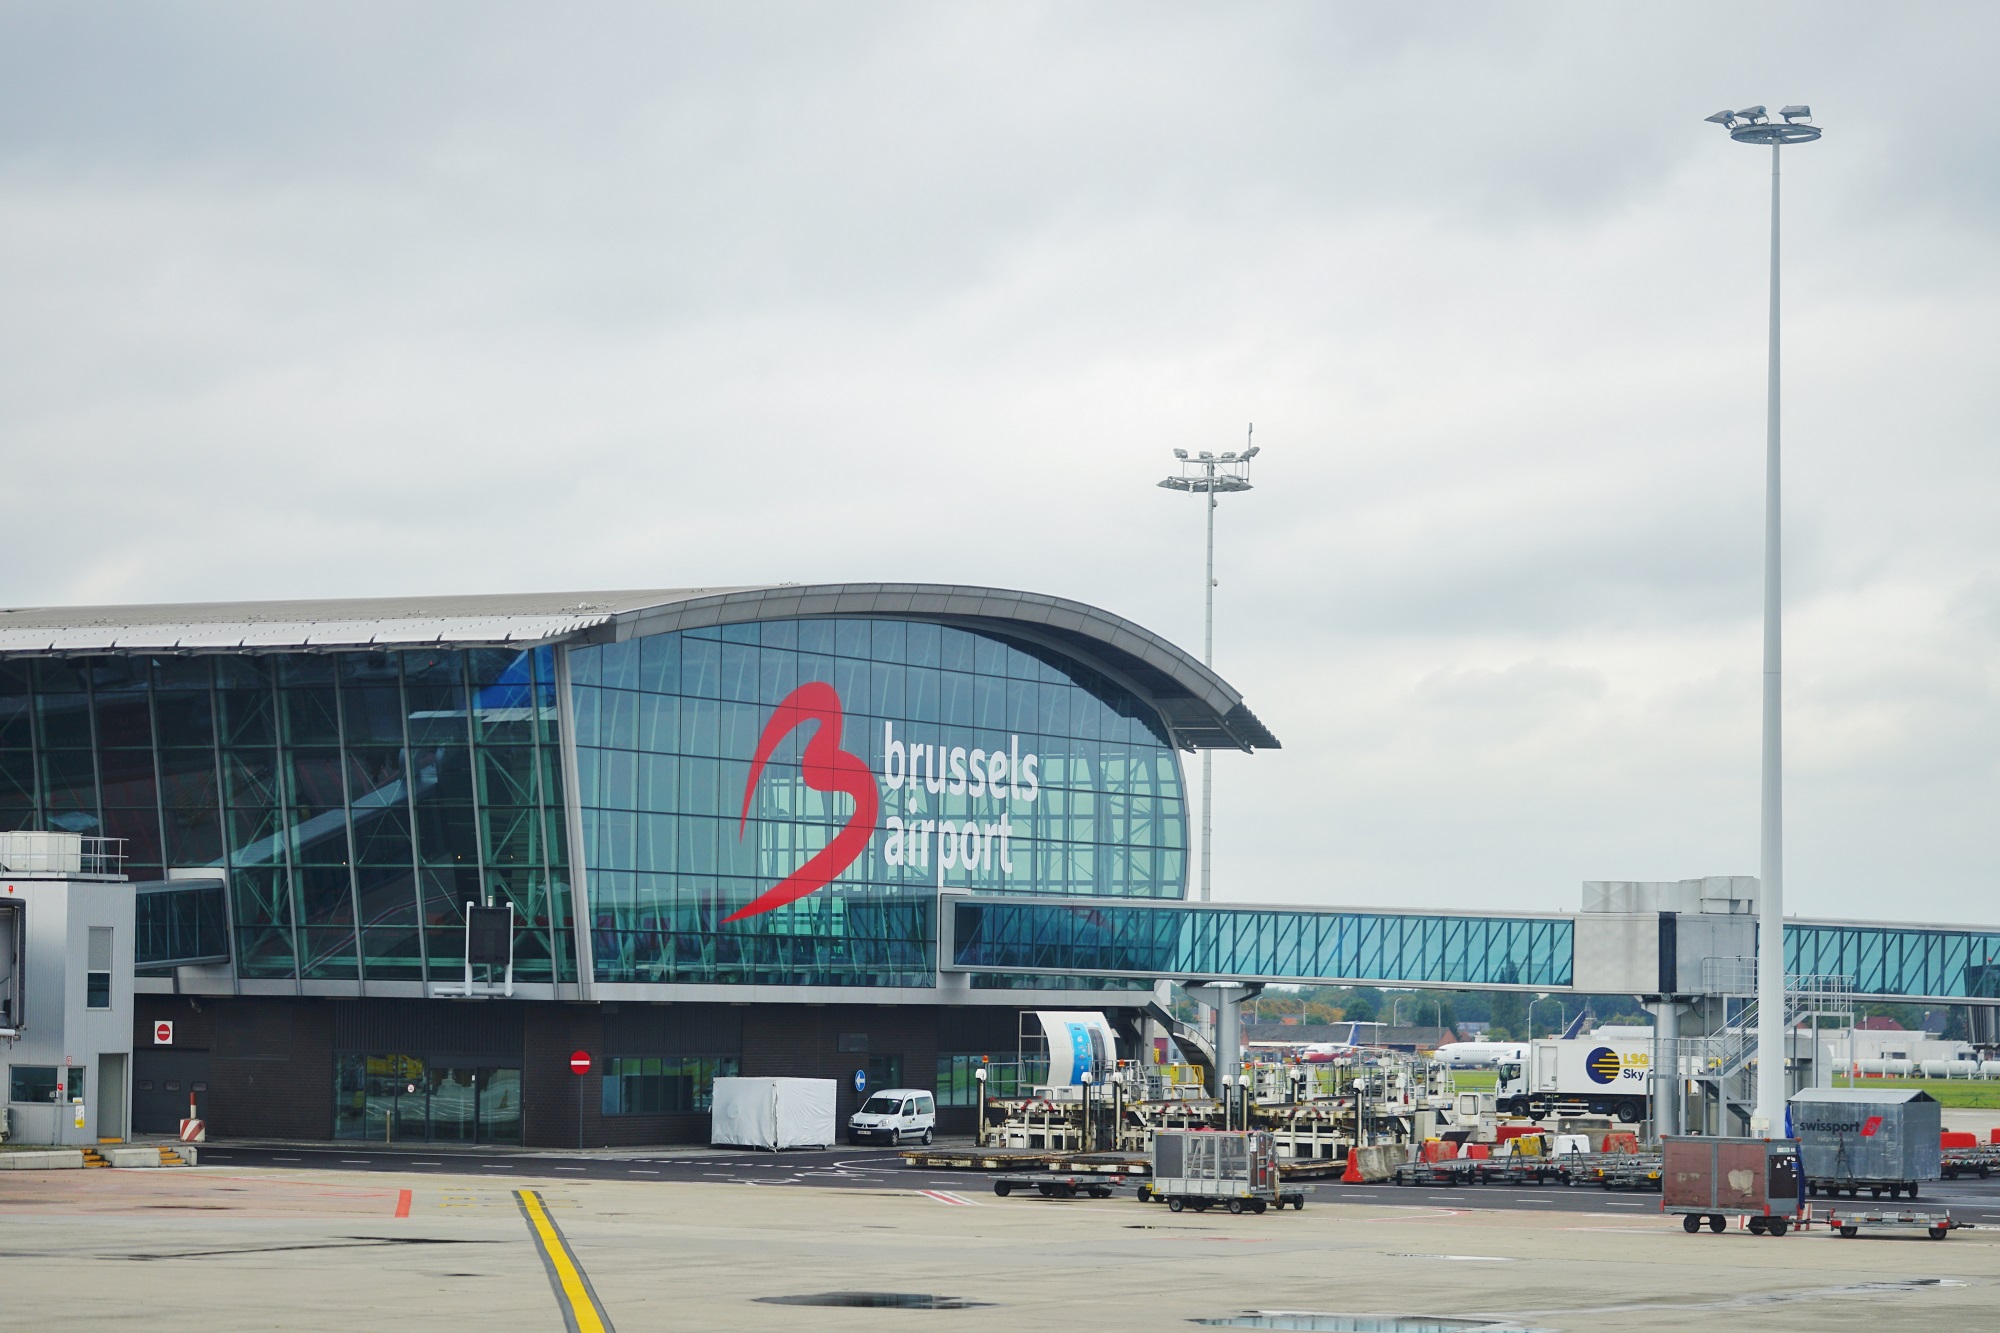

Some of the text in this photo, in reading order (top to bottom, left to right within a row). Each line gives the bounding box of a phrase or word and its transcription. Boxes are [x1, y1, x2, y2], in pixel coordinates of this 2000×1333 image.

[884, 721, 1039, 802] brussels
[884, 797, 1013, 887] airport
[1623, 1053, 1649, 1065] LSG
[1623, 1068, 1644, 1081] Sky
[1799, 1119, 1860, 1135] swissport
